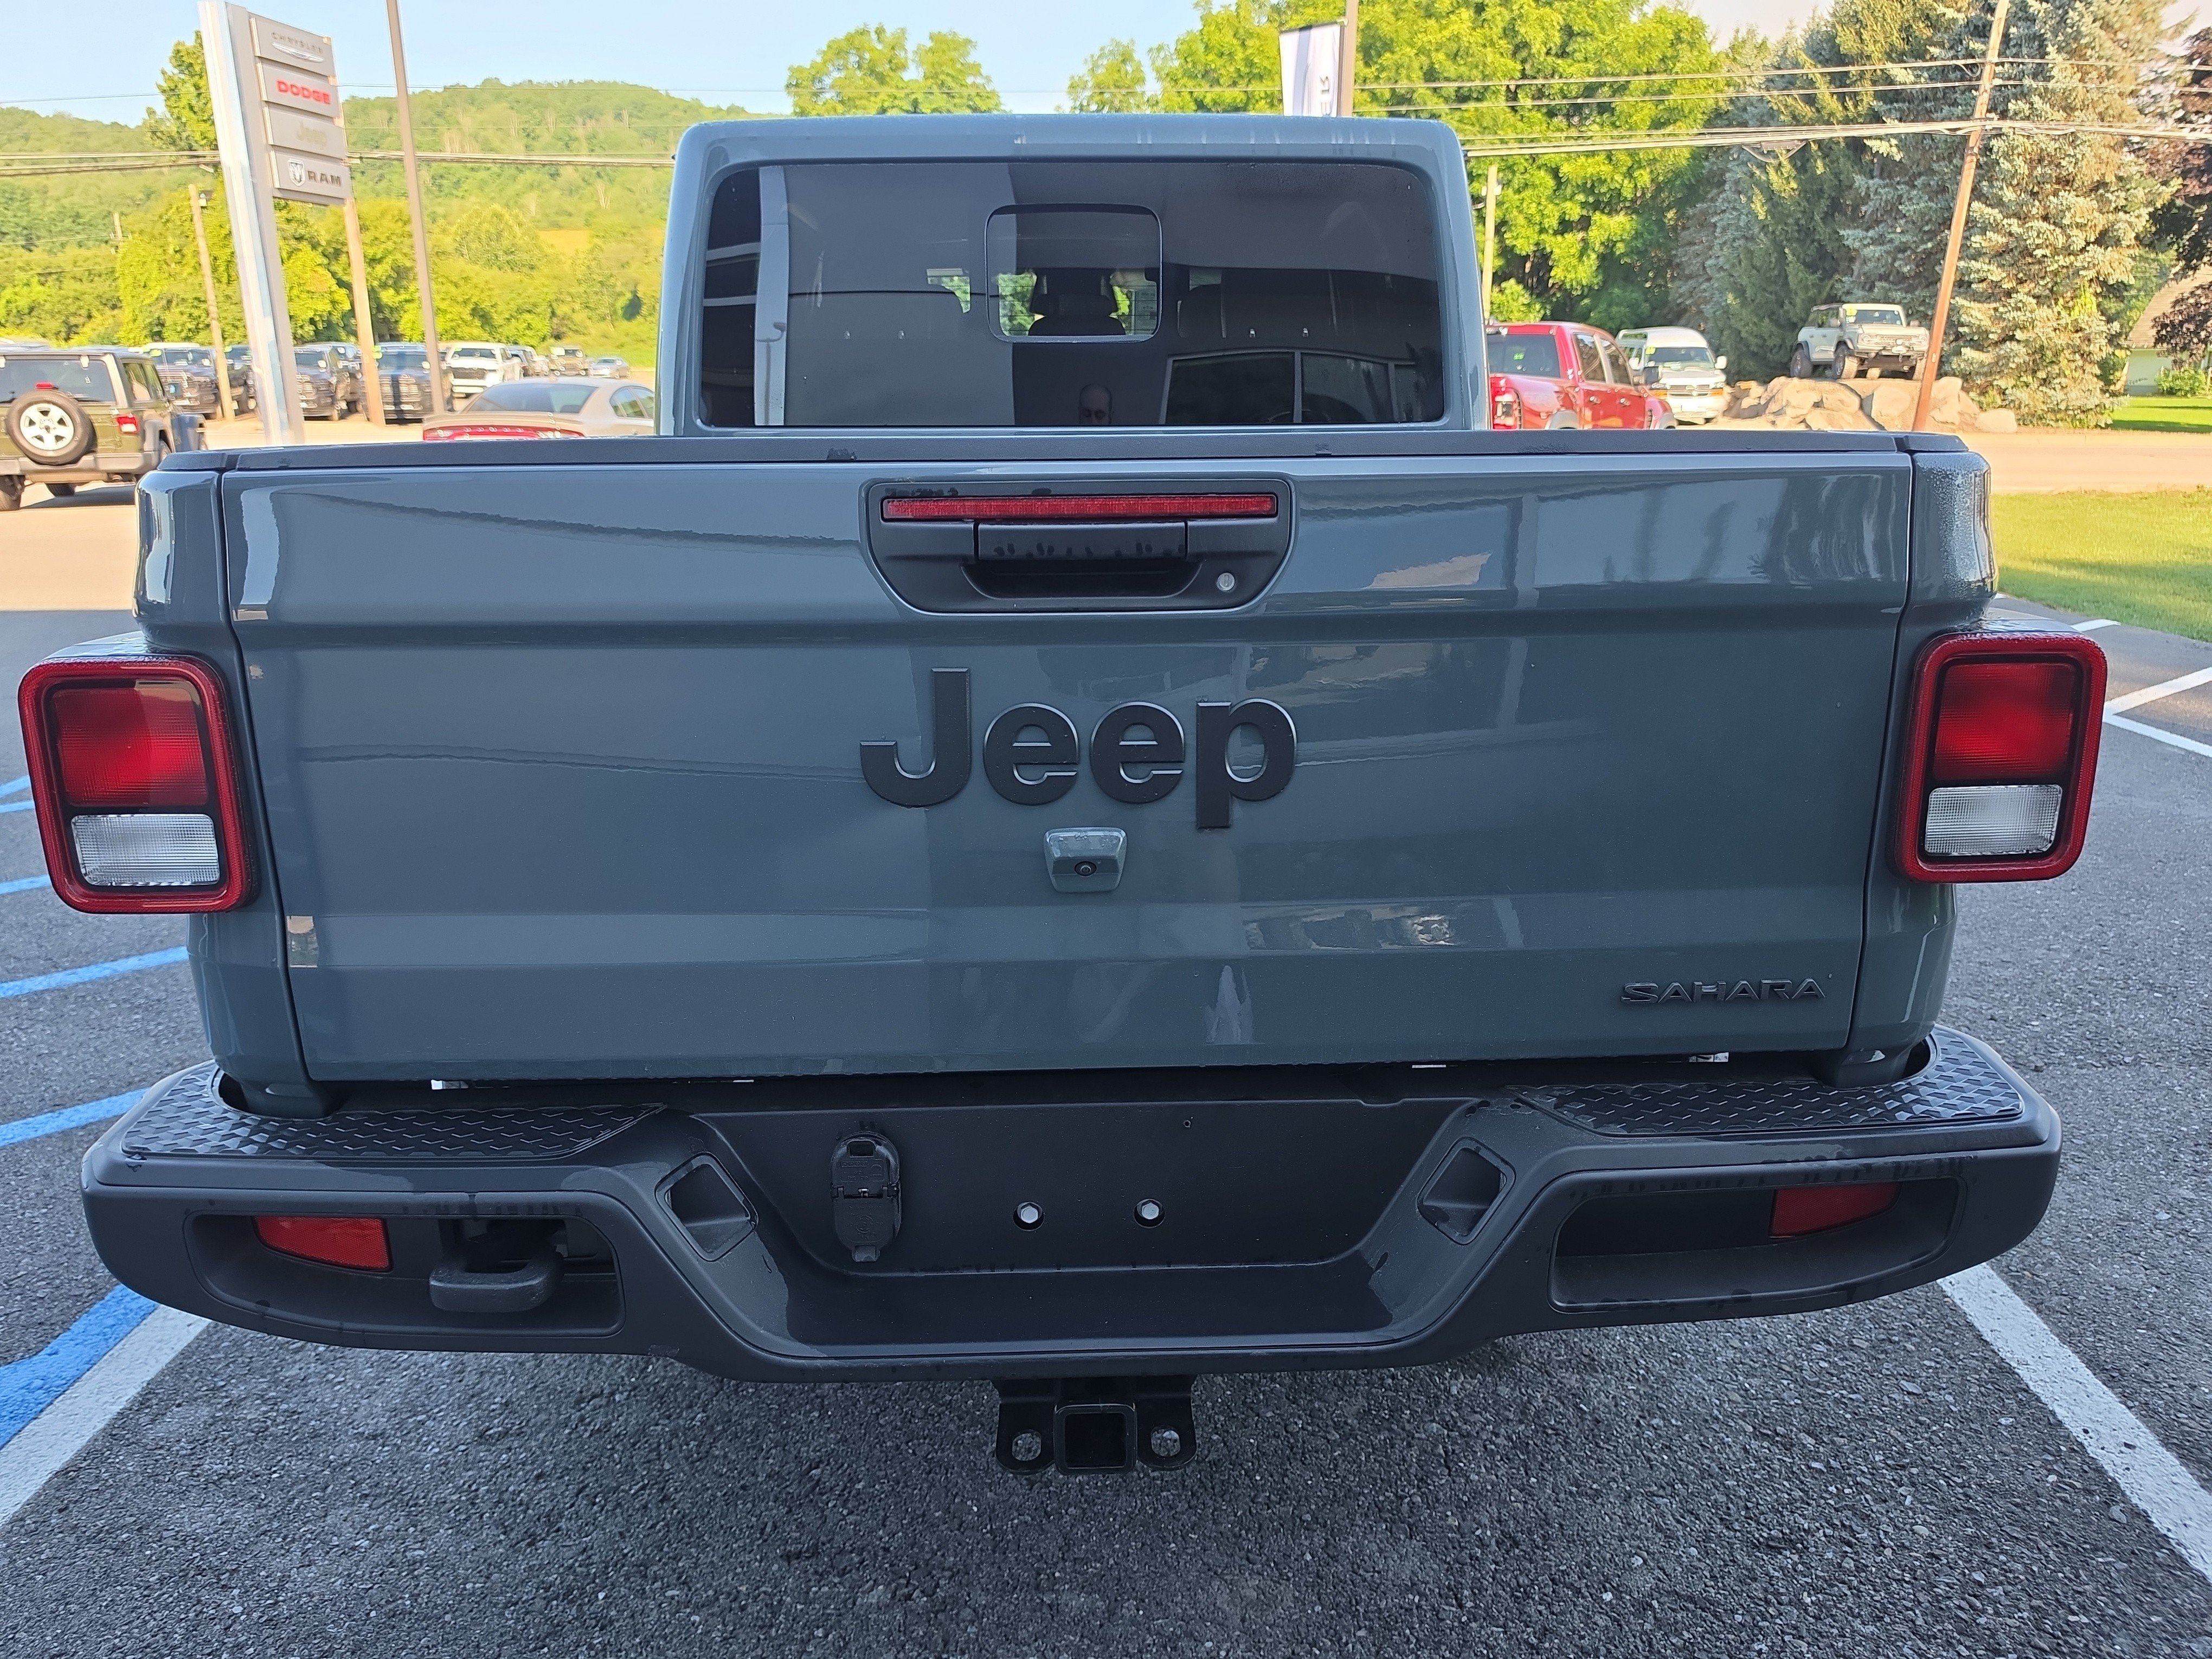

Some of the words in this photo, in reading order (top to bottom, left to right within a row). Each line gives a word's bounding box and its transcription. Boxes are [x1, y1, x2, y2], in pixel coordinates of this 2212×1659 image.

[276, 80, 331, 105] DODGE
[307, 170, 342, 187] RAM
[859, 667, 1297, 829] Jeep
[1621, 978, 1826, 1004] SAHARA
